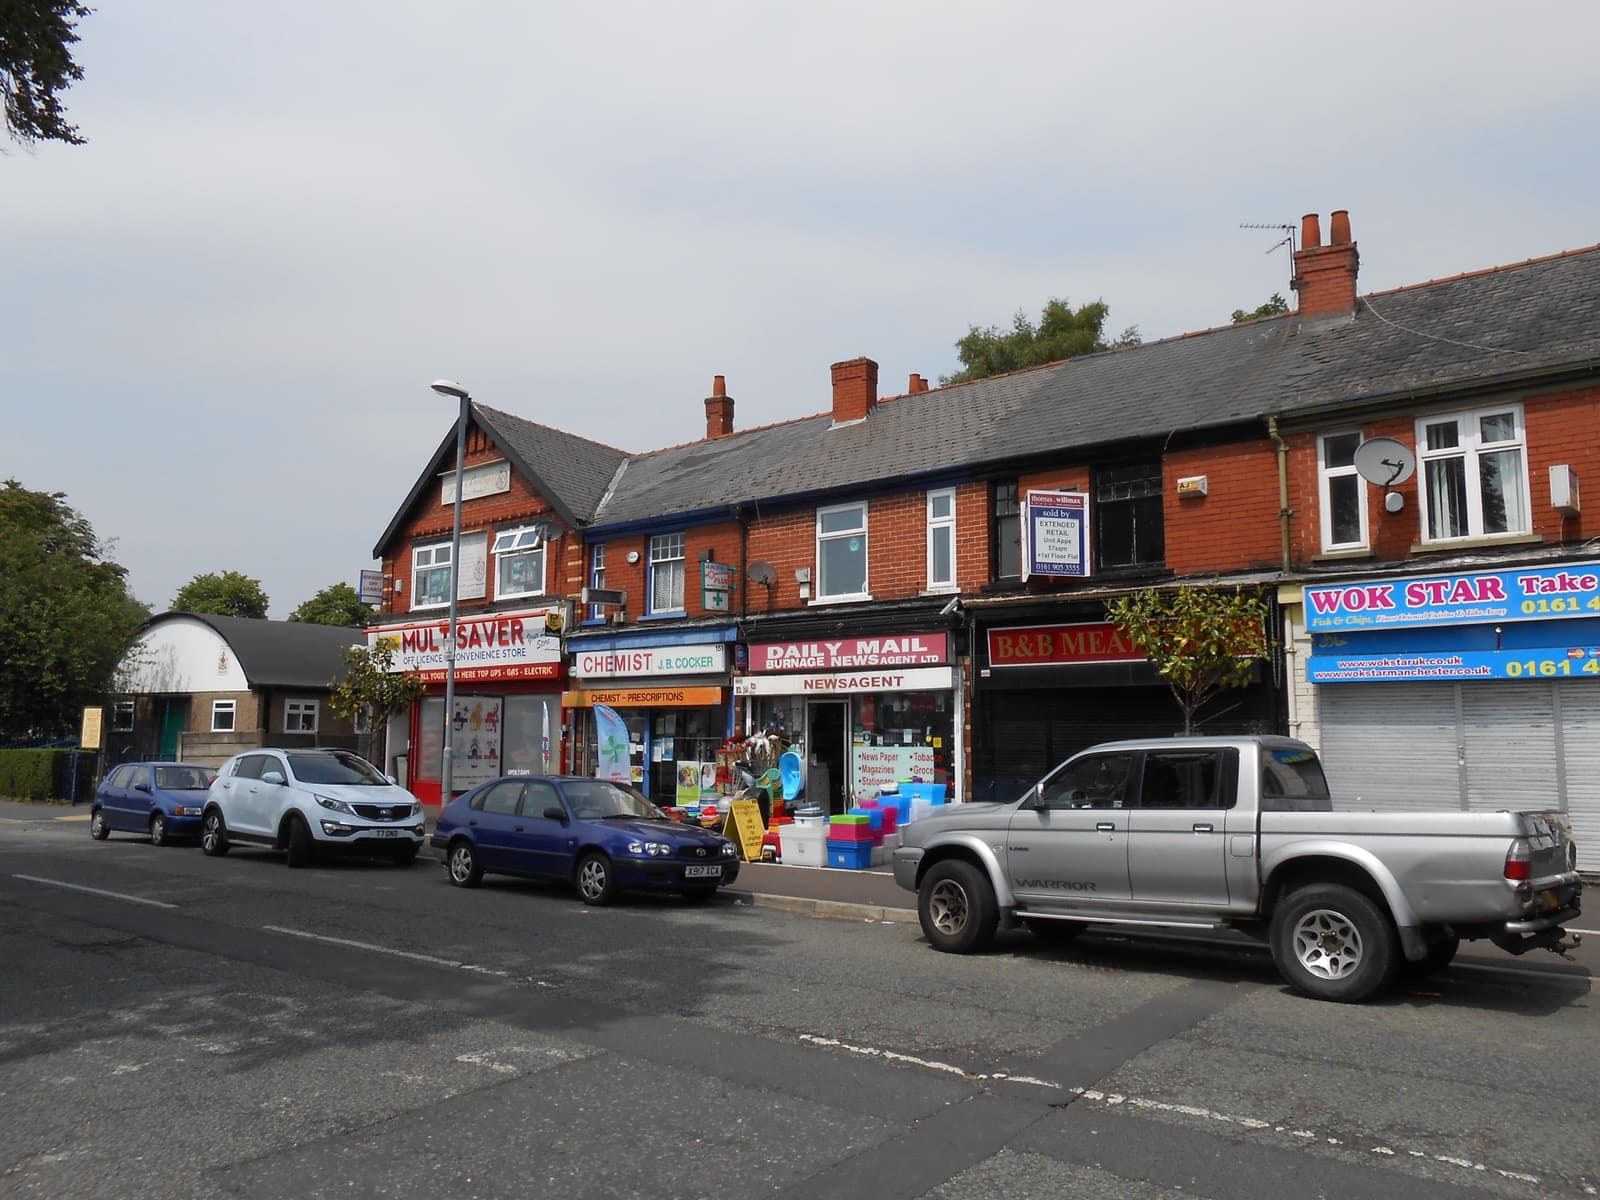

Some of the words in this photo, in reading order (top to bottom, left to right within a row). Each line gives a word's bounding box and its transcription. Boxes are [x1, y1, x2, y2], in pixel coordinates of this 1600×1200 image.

[1061, 510, 1070, 518] by
[1046, 529, 1069, 537] RETAIL
[1310, 586, 1394, 613] WOK
[1406, 577, 1506, 607] STAR
[1519, 573, 1597, 594] Take
[1521, 597, 1580, 614] 0161
[767, 642, 842, 659] DAILY
[856, 638, 928, 655] MAIL
[997, 633, 1054, 658] B&B
[403, 656, 414, 664] OFF
[455, 649, 500, 661] ONVENIENCE
[502, 648, 526, 658] STORE
[583, 653, 653, 673] CHEMIST
[675, 656, 713, 668] COCKER
[766, 656, 825, 669] BURNAGE
[921, 655, 939, 664] LTD
[1338, 657, 1463, 669] www.wokstaruk.co.uk
[430, 672, 445, 680] YOUR
[461, 671, 475, 679] HERE
[477, 670, 489, 678] TOP
[490, 669, 501, 677] UPS
[507, 668, 519, 677] GAS
[524, 666, 552, 676] ELECTRIC
[1314, 667, 1491, 679] www.wokstarmanchester.co.uk
[1506, 659, 1571, 677] 0161
[1582, 658, 1600, 675] 4
[804, 676, 904, 690] NEWSAGENT
[591, 694, 620, 703] CHEMIST
[627, 692, 684, 702] PRESCRIPTIONS
[861, 752, 877, 761] News
[880, 752, 898, 763] Paper
[862, 764, 894, 776] Magazines
[1015, 879, 1097, 892] WARRIOR
